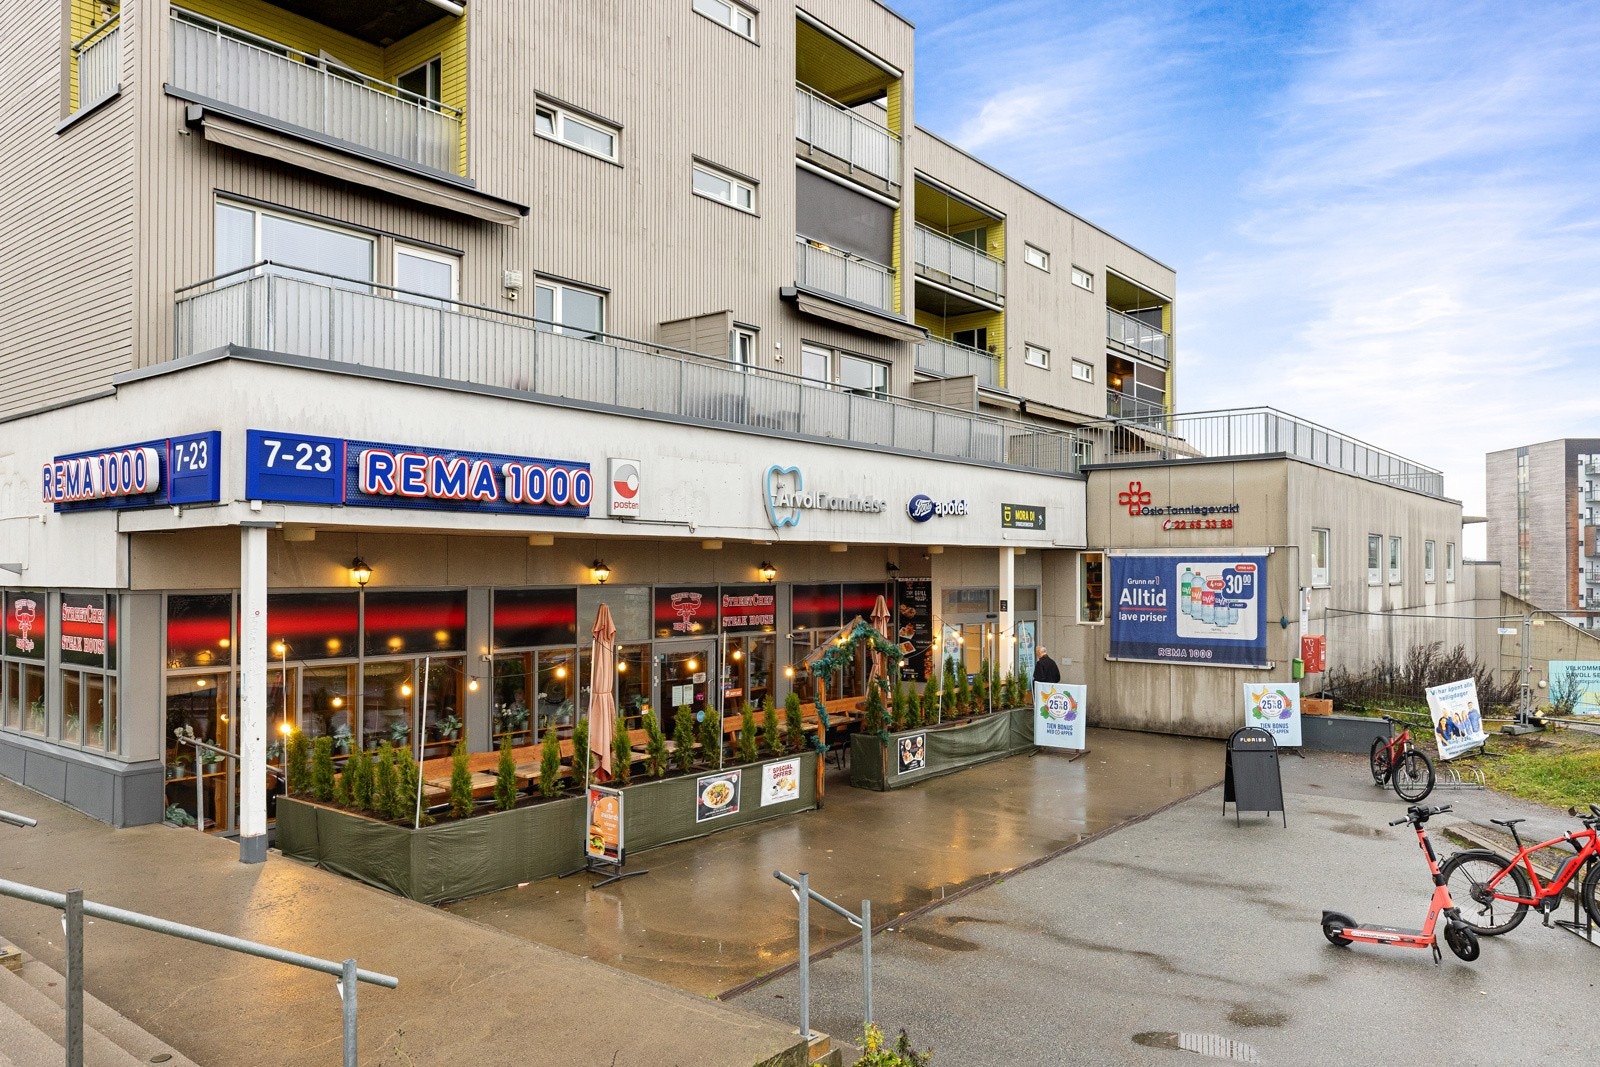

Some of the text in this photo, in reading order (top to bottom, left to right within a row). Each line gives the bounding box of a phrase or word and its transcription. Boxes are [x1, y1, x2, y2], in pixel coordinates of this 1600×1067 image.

[175, 440, 208, 472] 7-23
[263, 440, 332, 472] 7-23
[43, 447, 148, 503] REMA 1000
[364, 450, 593, 507] REMA 1000
[613, 501, 639, 510] posten
[935, 500, 969, 516] apotek
[1141, 503, 1239, 516] Oslo Tannlegevakt
[1174, 519, 1233, 529] 22 65 33 88
[1127, 577, 1147, 585] Grunn
[1155, 575, 1160, 585] 1
[1209, 580, 1214, 588] 4
[1225, 574, 1251, 594] 30 00
[1119, 587, 1167, 606] Alltid
[722, 614, 774, 627] STEAK HOUSE
[1118, 611, 1168, 622] lave priser
[62, 634, 83, 652] STEAK
[1157, 647, 1213, 659] REMA 1000
[1448, 683, 1463, 692] åpent
[1049, 699, 1059, 710] 25
[1063, 700, 1068, 710] 8
[1261, 699, 1272, 709] 25
[1276, 699, 1283, 709] 8
[1057, 723, 1073, 731] BONUS
[1272, 722, 1289, 730] BONUS
[773, 763, 793, 774] SPECIAL
[773, 770, 792, 780] OFFERS
